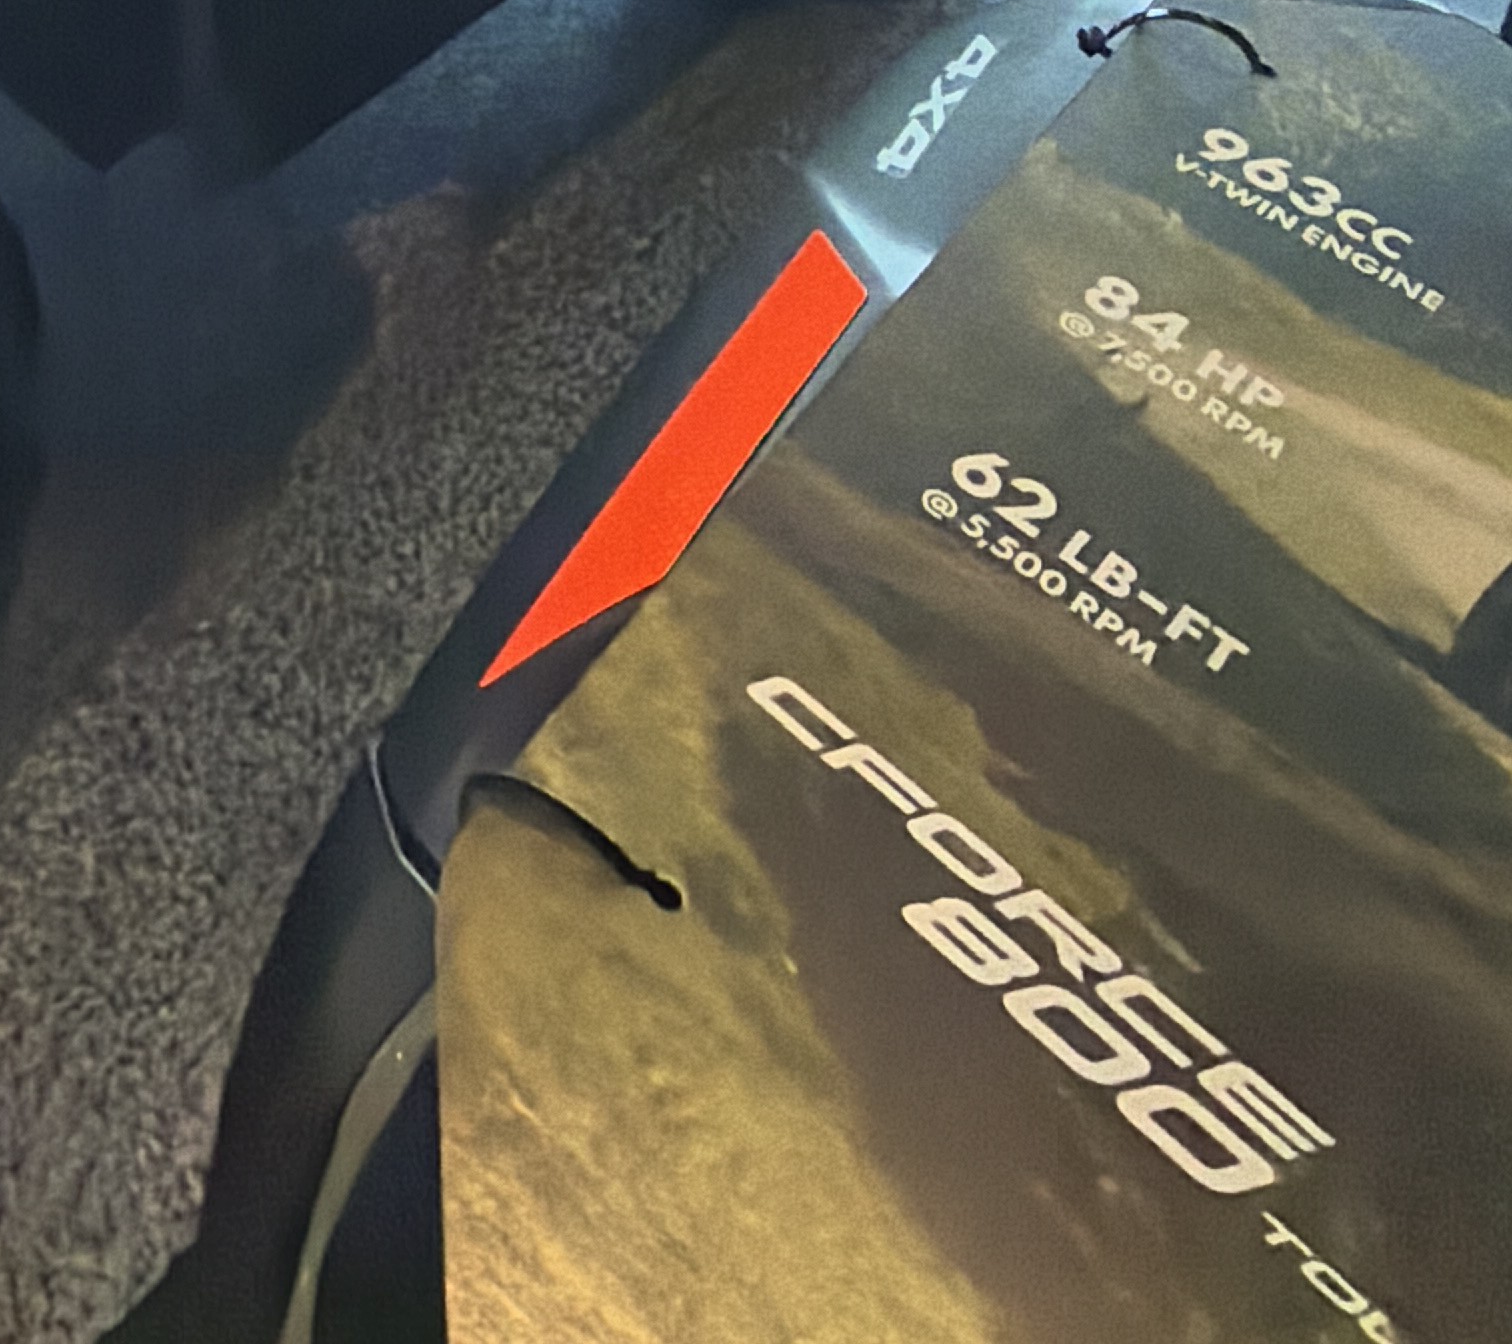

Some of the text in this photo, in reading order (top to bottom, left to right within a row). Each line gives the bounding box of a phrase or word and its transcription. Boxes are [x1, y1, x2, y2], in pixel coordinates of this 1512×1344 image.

[1175, 153, 1445, 313] V-TWIN ENGINE
[1085, 276, 1285, 407] 84 HP
[1097, 331, 1198, 402] 7,500
[1200, 396, 1285, 460] RPM
[951, 452, 1251, 672] 62 LB-FT
[960, 513, 1068, 596] 5,500
[1069, 590, 1158, 666] RPM
[746, 675, 1336, 1160] CFORCE
[900, 896, 1275, 1194] 800
